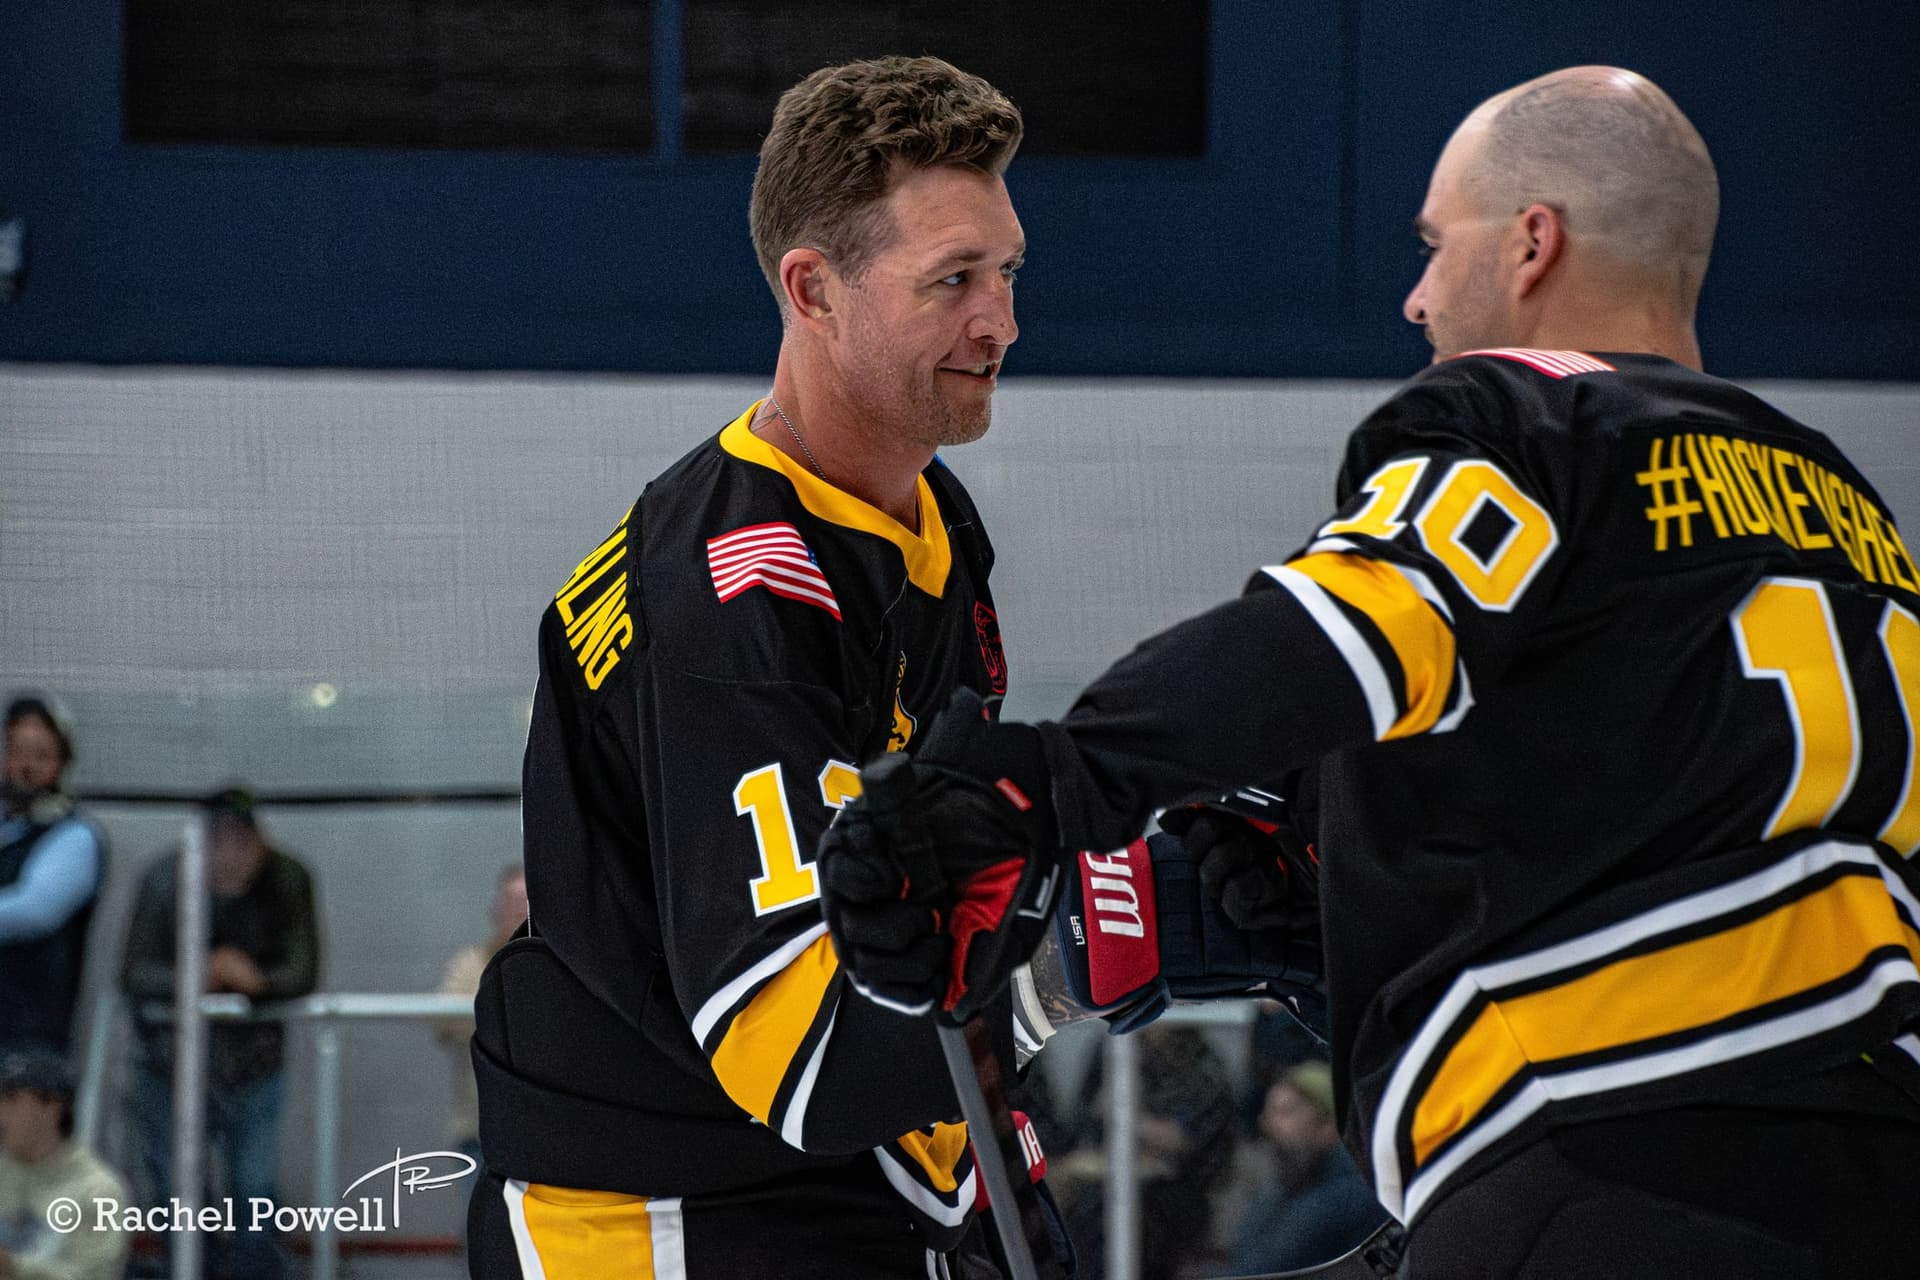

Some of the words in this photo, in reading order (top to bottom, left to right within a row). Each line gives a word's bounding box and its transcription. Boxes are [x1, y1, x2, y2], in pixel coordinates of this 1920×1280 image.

[1317, 456, 1560, 614] 10
[1635, 433, 1920, 595] #HOCKEYISHE
[555, 503, 634, 690] ALING
[1069, 915, 1086, 946] USA
